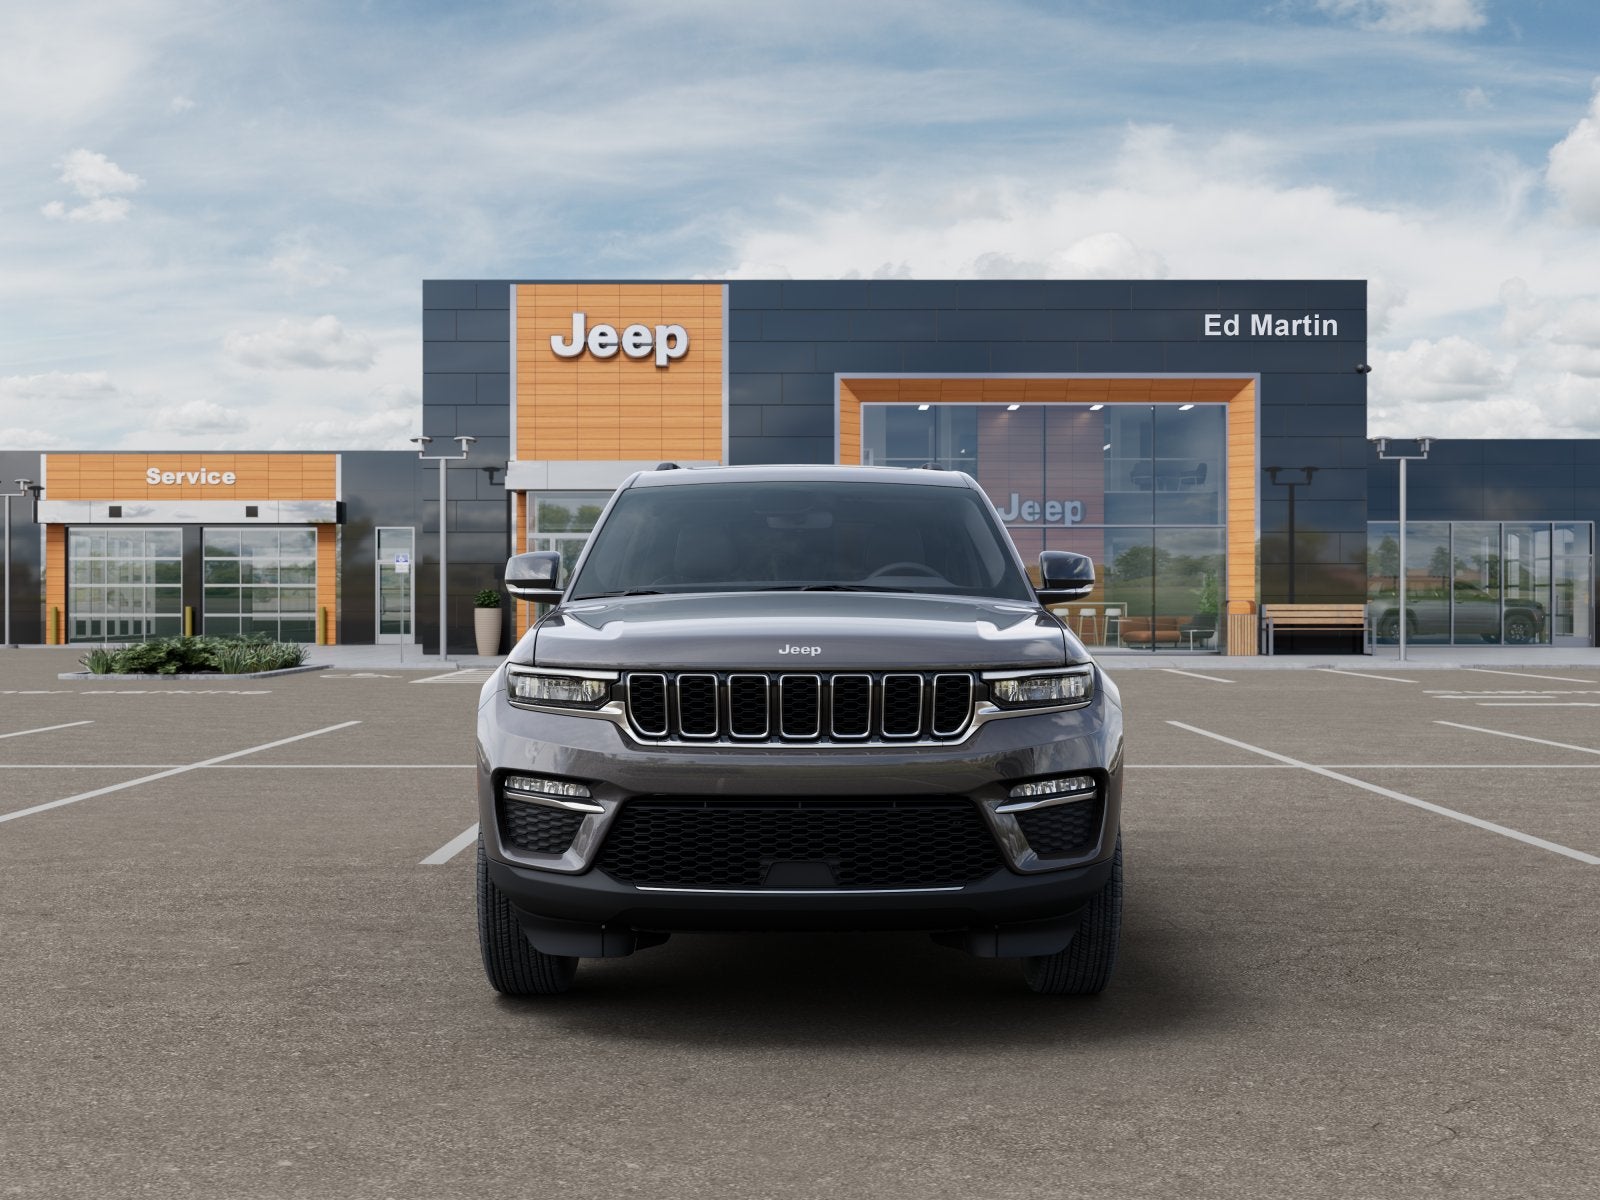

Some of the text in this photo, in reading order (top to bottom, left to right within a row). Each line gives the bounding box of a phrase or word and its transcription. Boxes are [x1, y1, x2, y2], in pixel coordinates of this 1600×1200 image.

[1204, 313, 1338, 336] Ed Martin
[550, 312, 690, 368] Jeep
[145, 467, 237, 485] Service
[997, 493, 1083, 527] Jeep
[778, 644, 822, 657] Jeep
